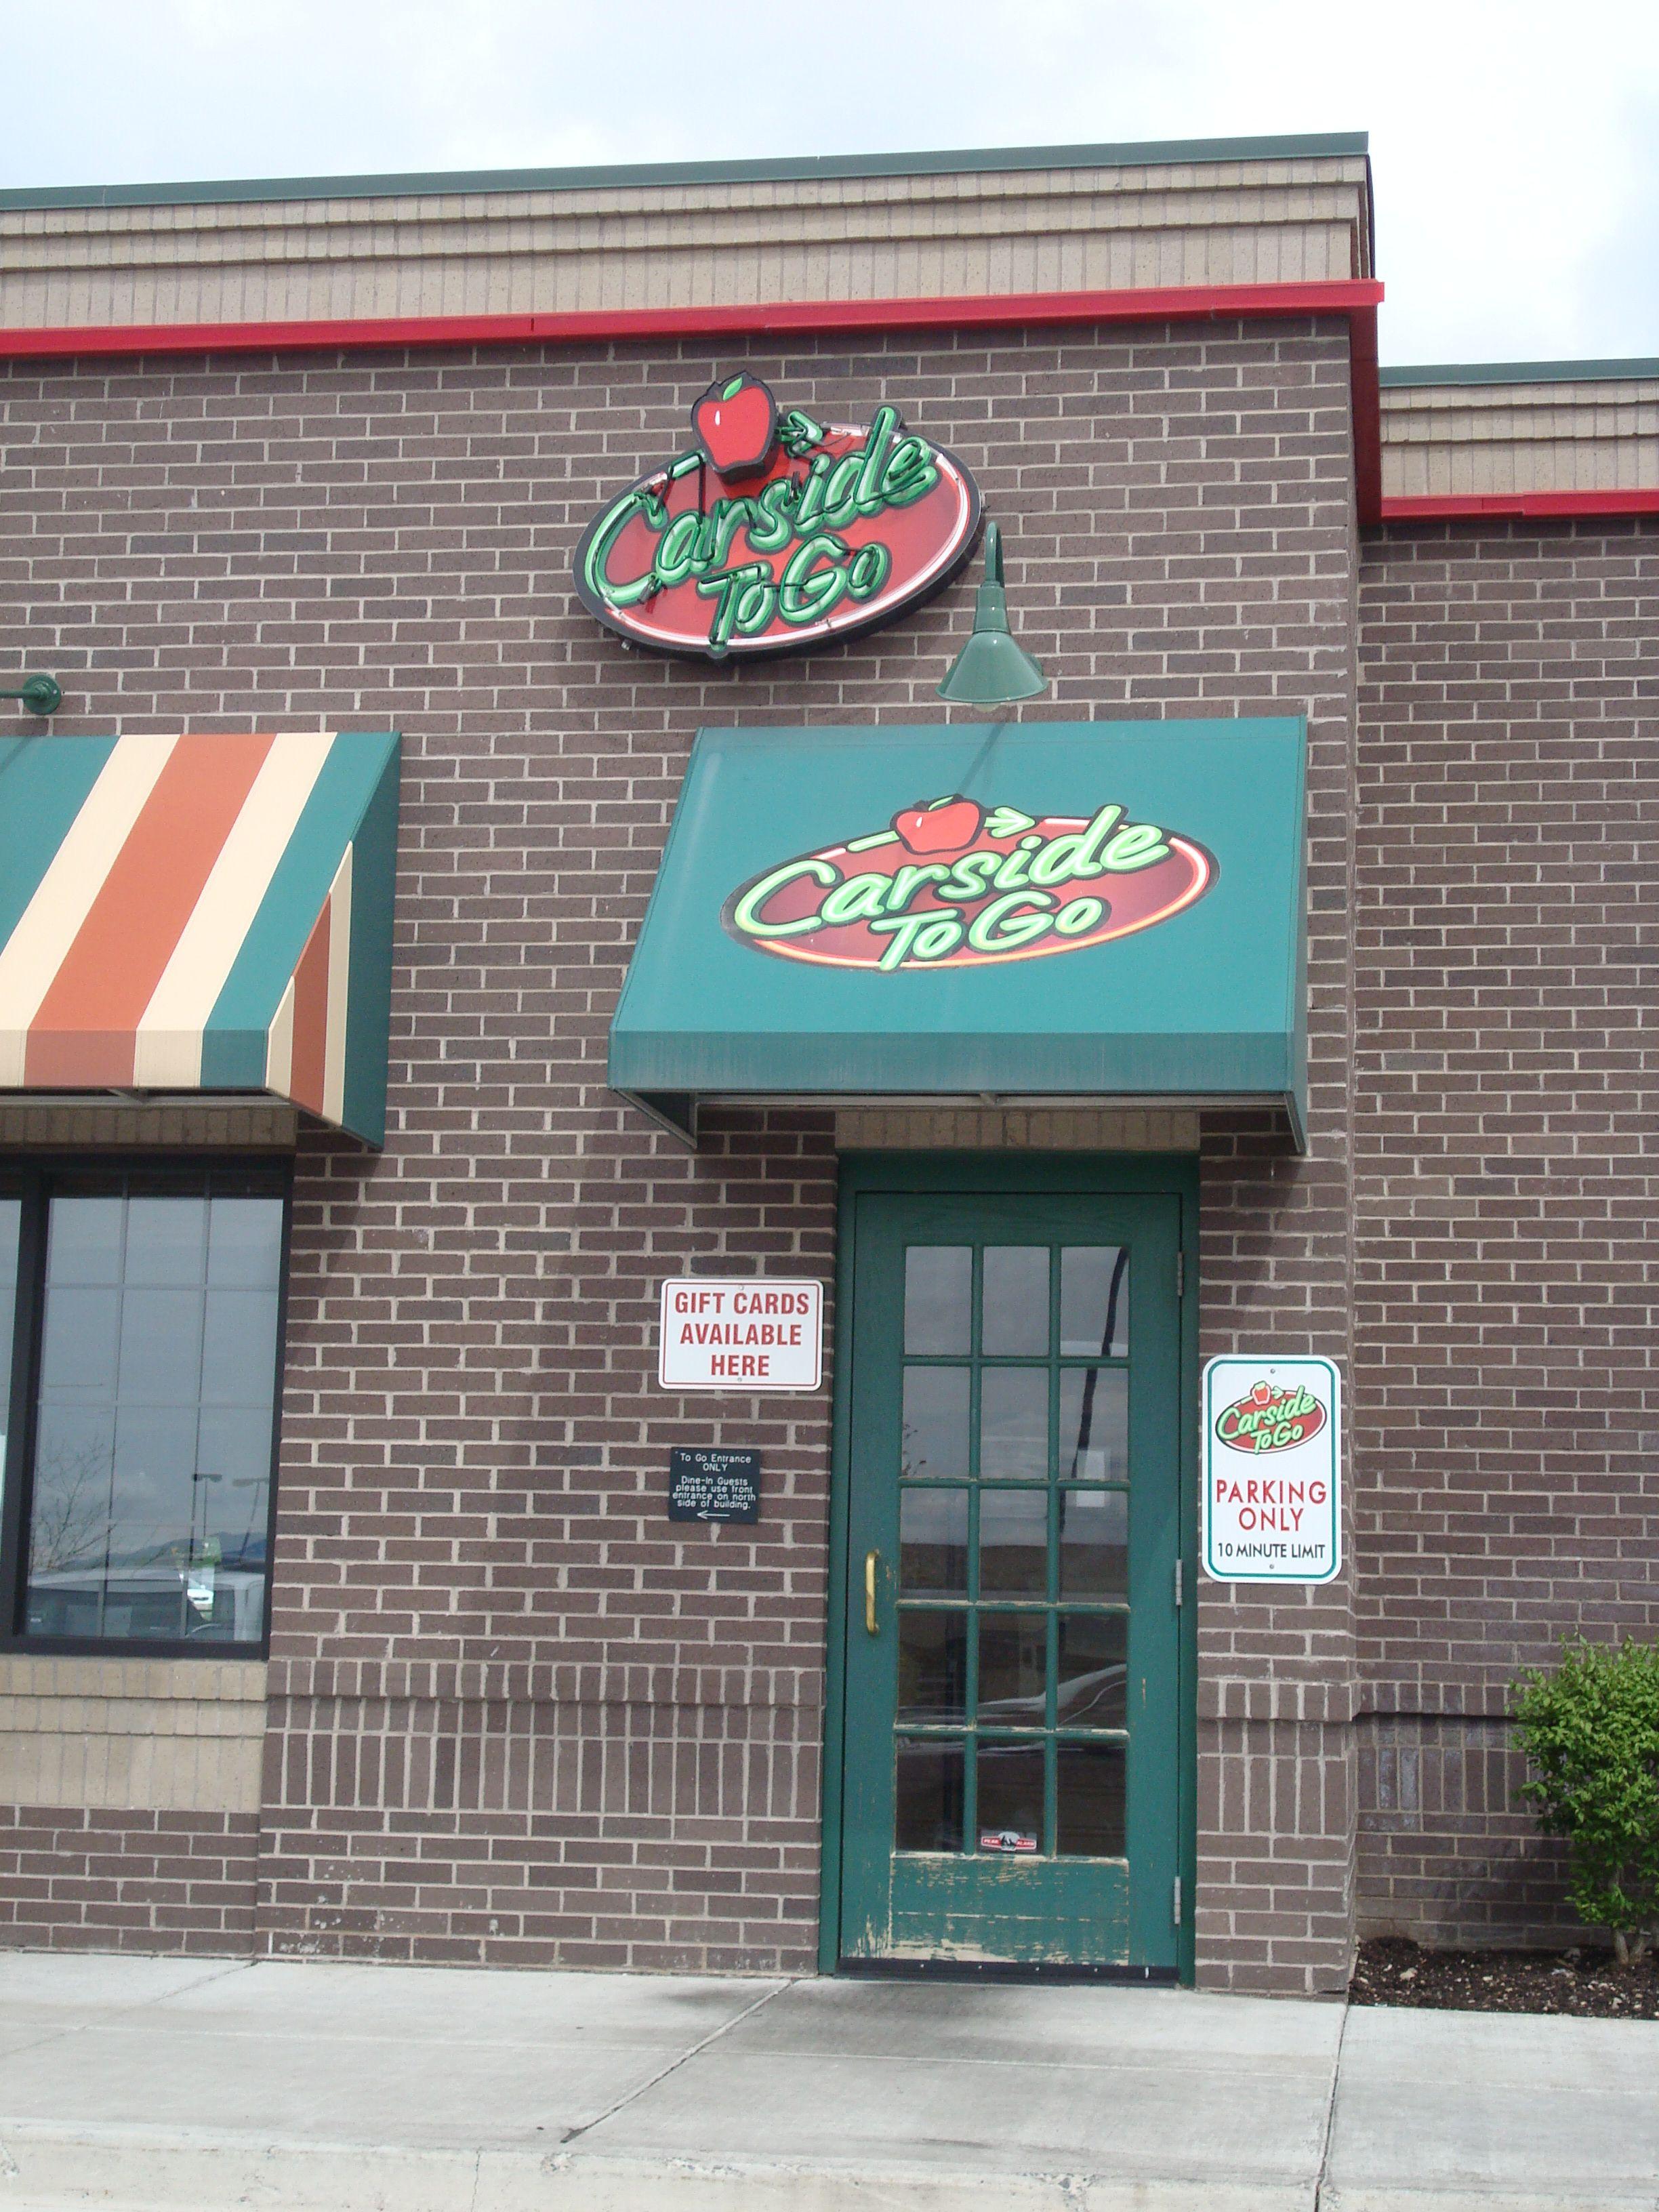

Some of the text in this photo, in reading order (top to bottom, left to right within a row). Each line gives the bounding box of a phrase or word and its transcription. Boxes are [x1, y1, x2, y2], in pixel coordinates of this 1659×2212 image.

[585, 407, 938, 605] Carside
[698, 535, 888, 649] To Go
[735, 804, 1170, 936] Carside
[869, 890, 1103, 971] To Go
[675, 1292, 809, 1315] GIFT CARDS
[680, 1324, 802, 1345] AVAILABLE
[711, 1355, 770, 1376] HERE
[1218, 1385, 1317, 1440] Carside
[1250, 1421, 1303, 1454] To Go
[680, 1453, 752, 1463] To Go Entrance
[703, 1462, 728, 1471] ONLY
[676, 1484, 707, 1492] please
[731, 1485, 753, 1494] front
[681, 1475, 748, 1486] Dine-In Guests
[1216, 1479, 1327, 1504] PARKING
[672, 1492, 712, 1500] entrance
[733, 1493, 756, 1501] north
[677, 1499, 751, 1510] side of building.
[1239, 1507, 1304, 1532] ONLY
[1218, 1542, 1326, 1559] 10 MINUTE LIMIT
